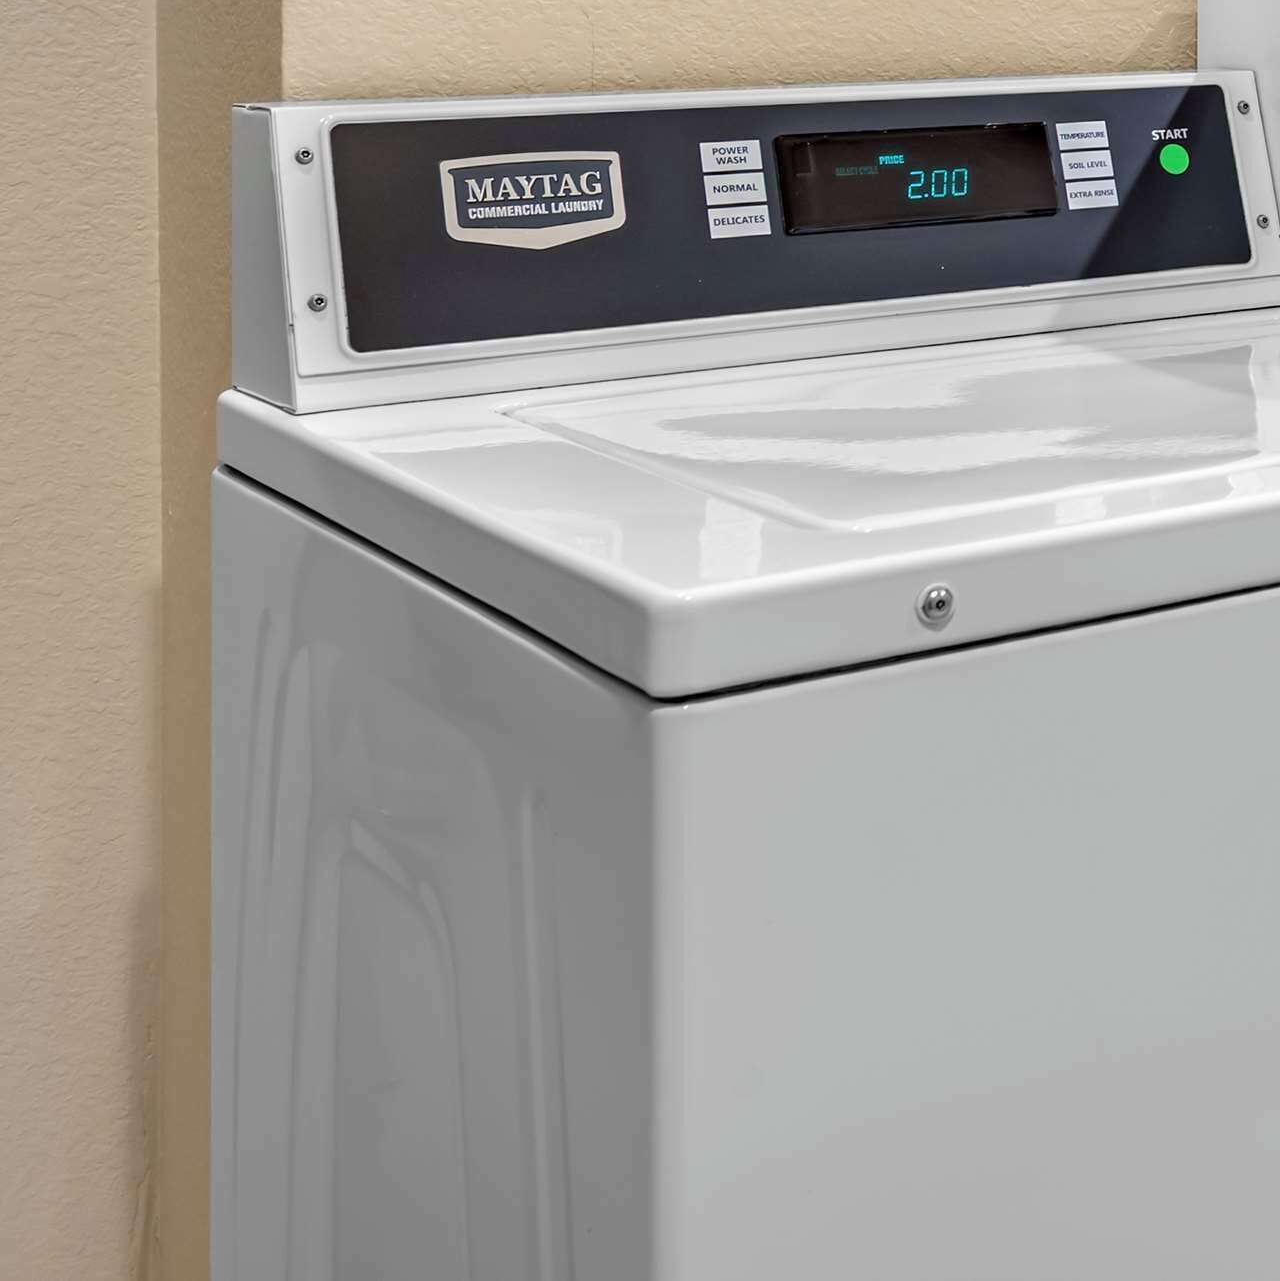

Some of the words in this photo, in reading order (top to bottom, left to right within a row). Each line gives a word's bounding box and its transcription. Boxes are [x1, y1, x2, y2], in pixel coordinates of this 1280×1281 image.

[1059, 131, 1105, 140] TEMPERATURE
[1151, 128, 1188, 141] START
[711, 146, 749, 156] POWER
[715, 155, 747, 165] WASH
[878, 155, 905, 165] PRICE
[1068, 162, 1085, 170] SOIL
[1086, 160, 1108, 168] LEVEL
[465, 170, 604, 204] MAYTAG
[712, 183, 758, 194] NORMAL
[907, 168, 968, 200] 2.00
[1069, 190, 1093, 199] EXTRA
[1094, 189, 1115, 197] RINSE
[467, 202, 549, 220] COMMERCIAL
[550, 199, 604, 215] LAUNDRY
[713, 215, 766, 227] DELICATES
